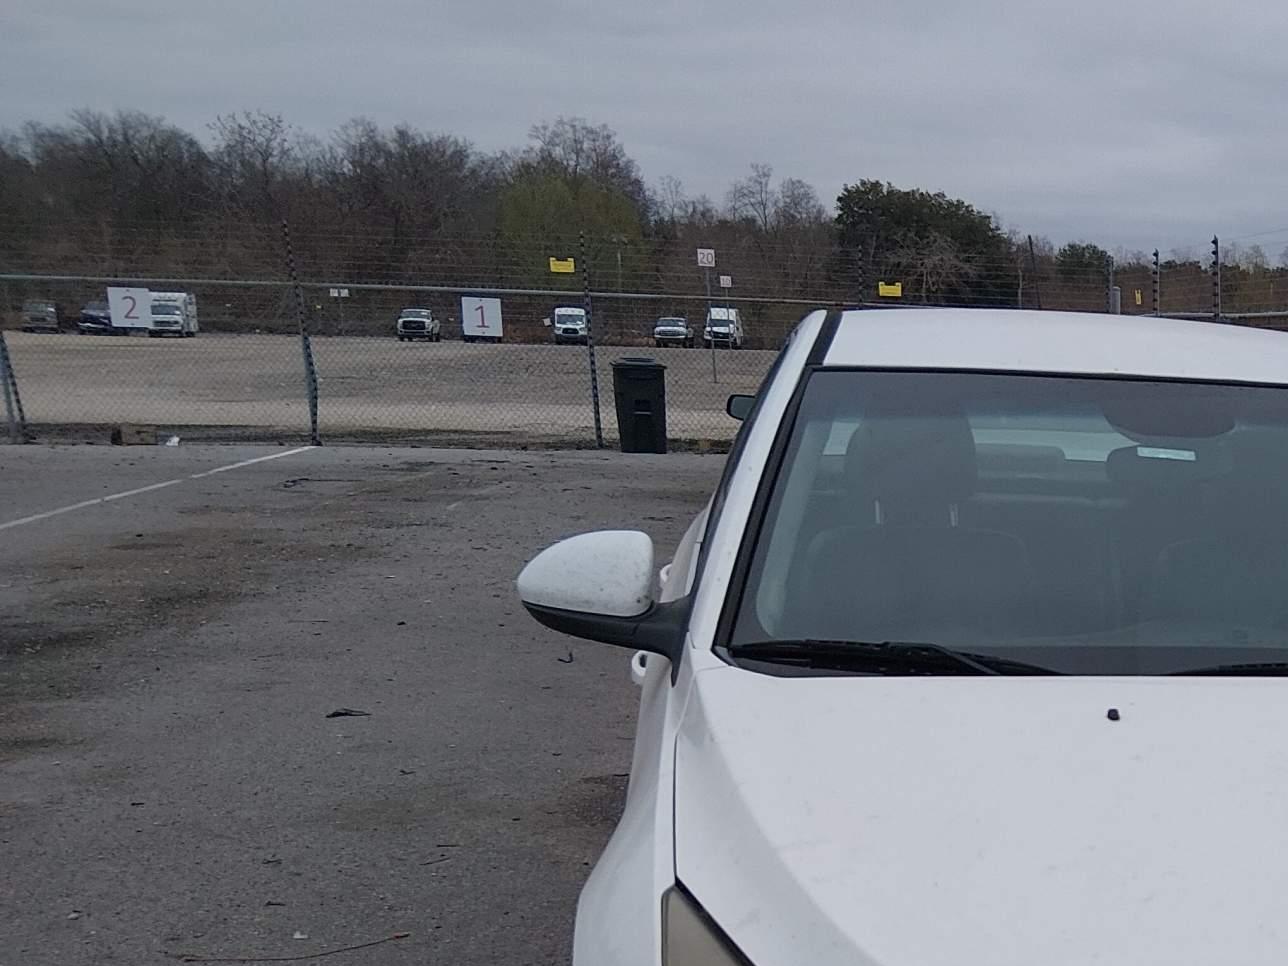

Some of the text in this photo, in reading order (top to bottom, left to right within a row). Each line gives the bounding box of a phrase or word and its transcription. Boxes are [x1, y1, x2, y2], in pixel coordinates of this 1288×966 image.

[698, 252, 714, 265] 20
[121, 295, 140, 320] 2
[473, 304, 491, 329] 1
